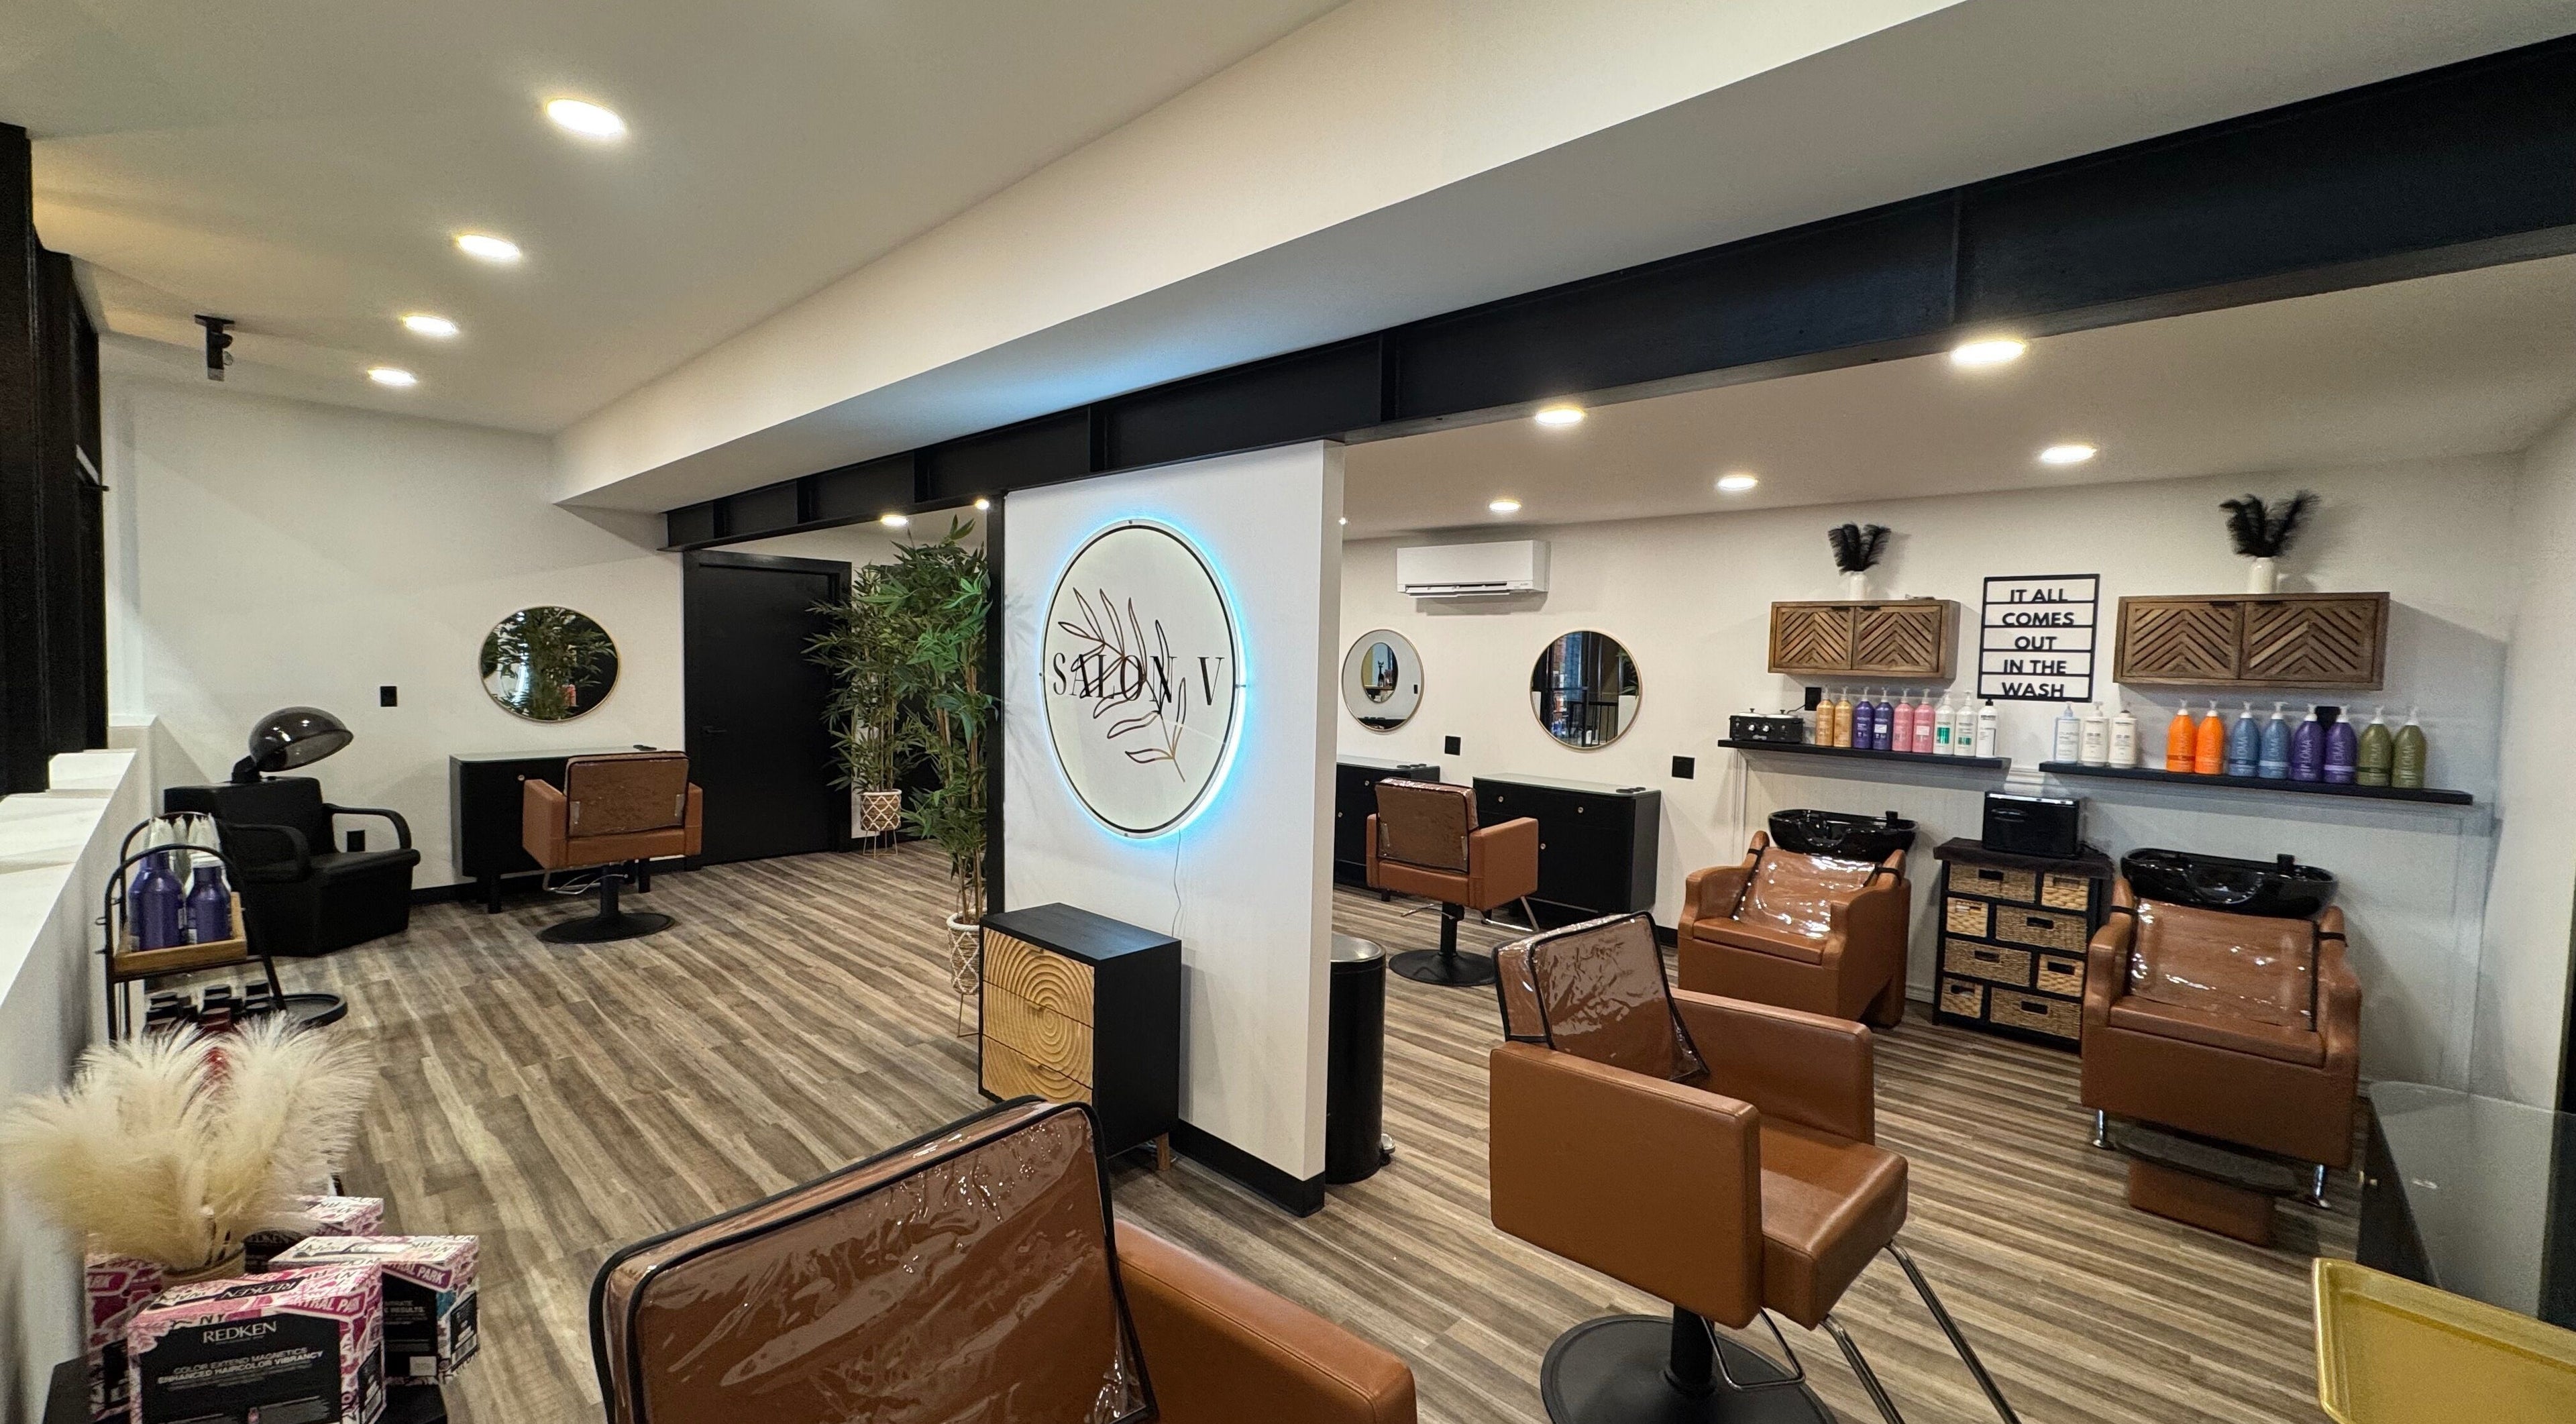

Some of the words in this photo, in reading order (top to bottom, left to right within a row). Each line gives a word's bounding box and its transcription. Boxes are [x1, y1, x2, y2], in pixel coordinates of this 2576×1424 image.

[2010, 589, 2027, 602] IT
[2031, 588, 2068, 602] ALL
[2002, 612, 2075, 626] COMES
[2015, 636, 2057, 650] OUT
[2003, 659, 2024, 673] IN
[2030, 659, 2068, 674] THE
[1053, 652, 1177, 704] SALON
[1197, 656, 1225, 706] V
[2002, 681, 2065, 698] WASH
[417, 1266, 445, 1284] PARK
[221, 1279, 297, 1300] REDKEN
[203, 1321, 278, 1344] REDKEN
[158, 1369, 213, 1384] ENHANCED
[214, 1360, 272, 1376] HAIRCOLOR
[274, 1350, 324, 1366] VIBRANCY
[173, 1363, 209, 1375] COLOR
[210, 1356, 250, 1370] EXTEND
[251, 1347, 308, 1366] MAGNETICS
